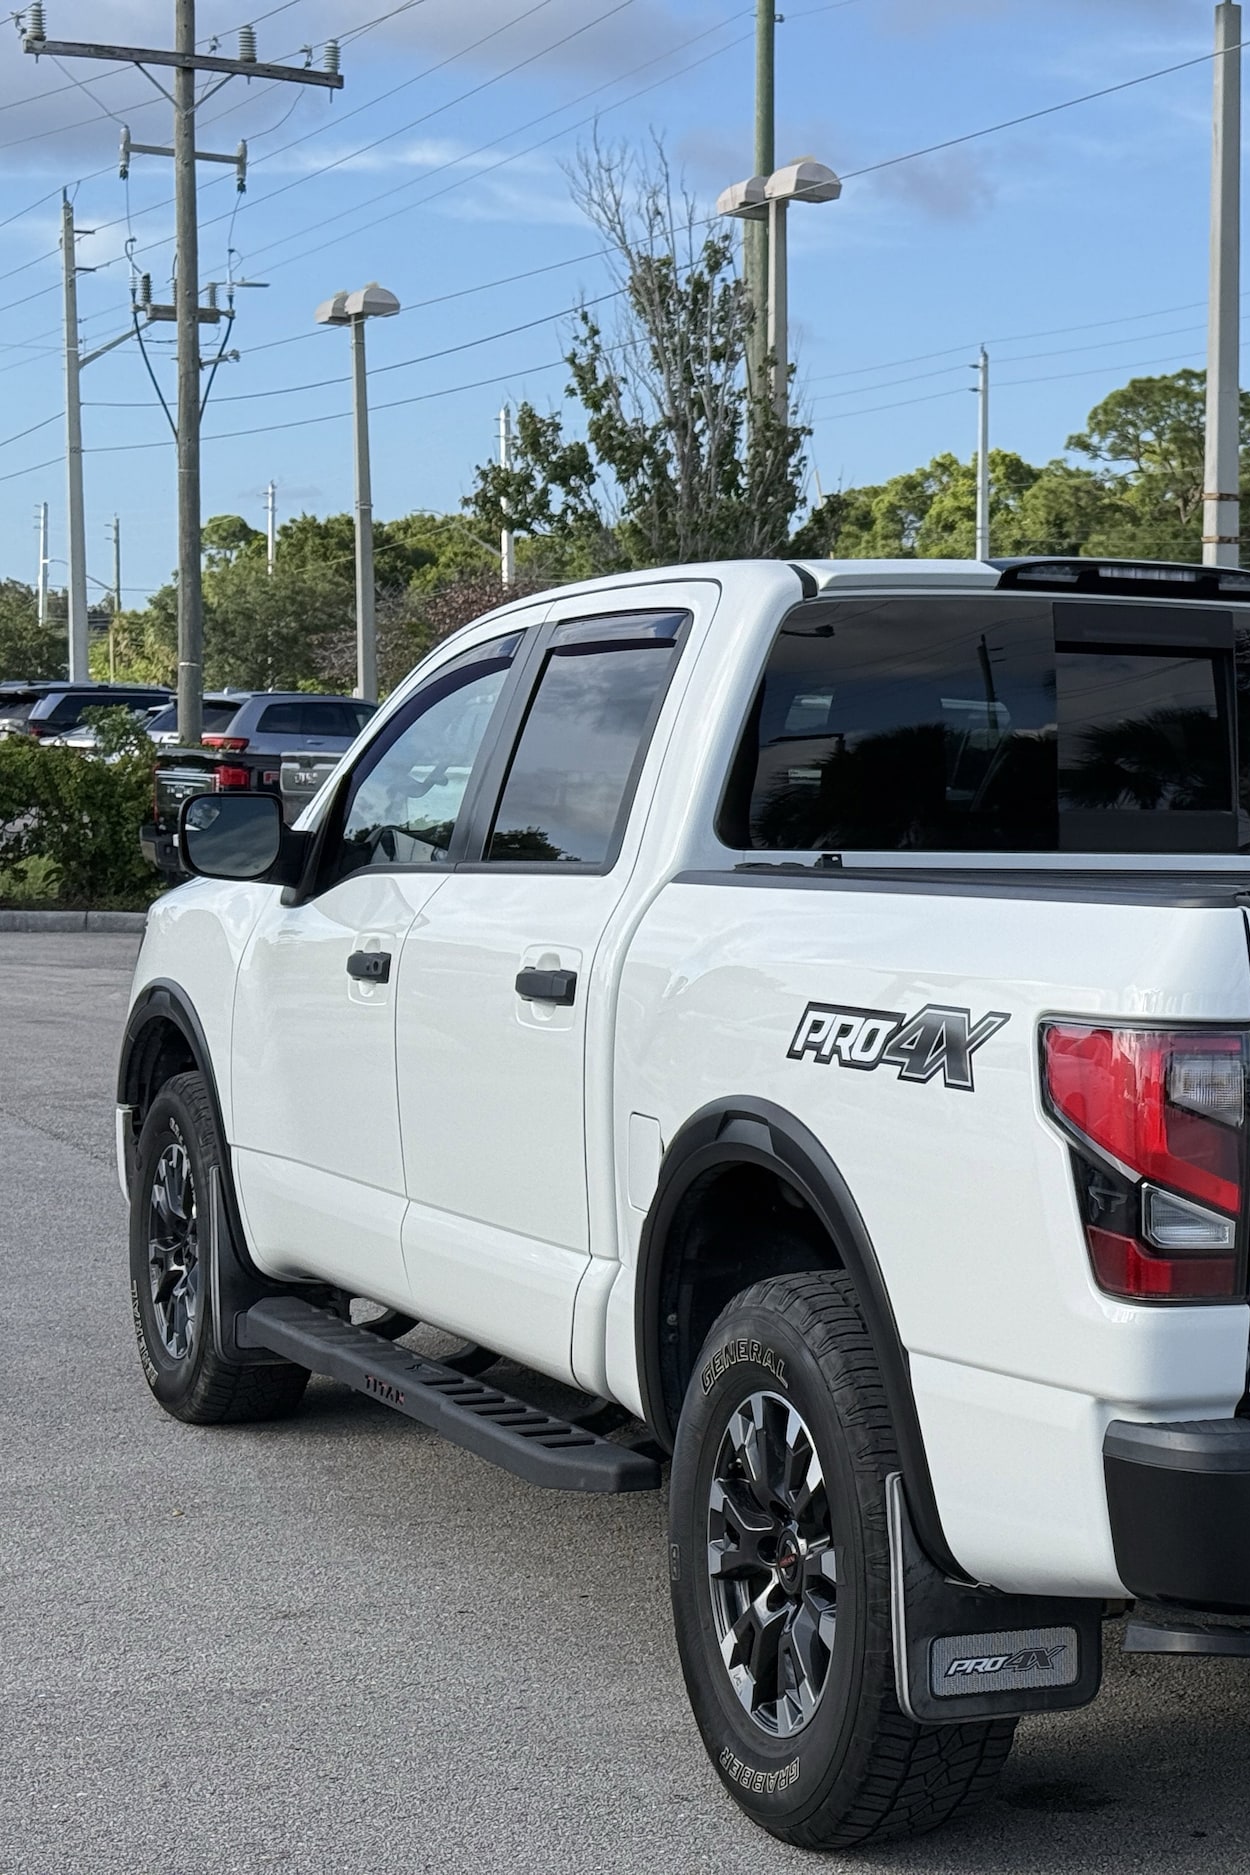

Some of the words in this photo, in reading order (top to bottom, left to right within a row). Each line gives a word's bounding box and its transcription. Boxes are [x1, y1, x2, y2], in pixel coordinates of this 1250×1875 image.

[786, 1001, 1012, 1092] PRO4X
[364, 1374, 405, 1406] TITAN
[700, 1338, 789, 1396] GENERAL
[943, 1645, 1067, 1678] PRO4X
[719, 1746, 800, 1793] GRABBER
